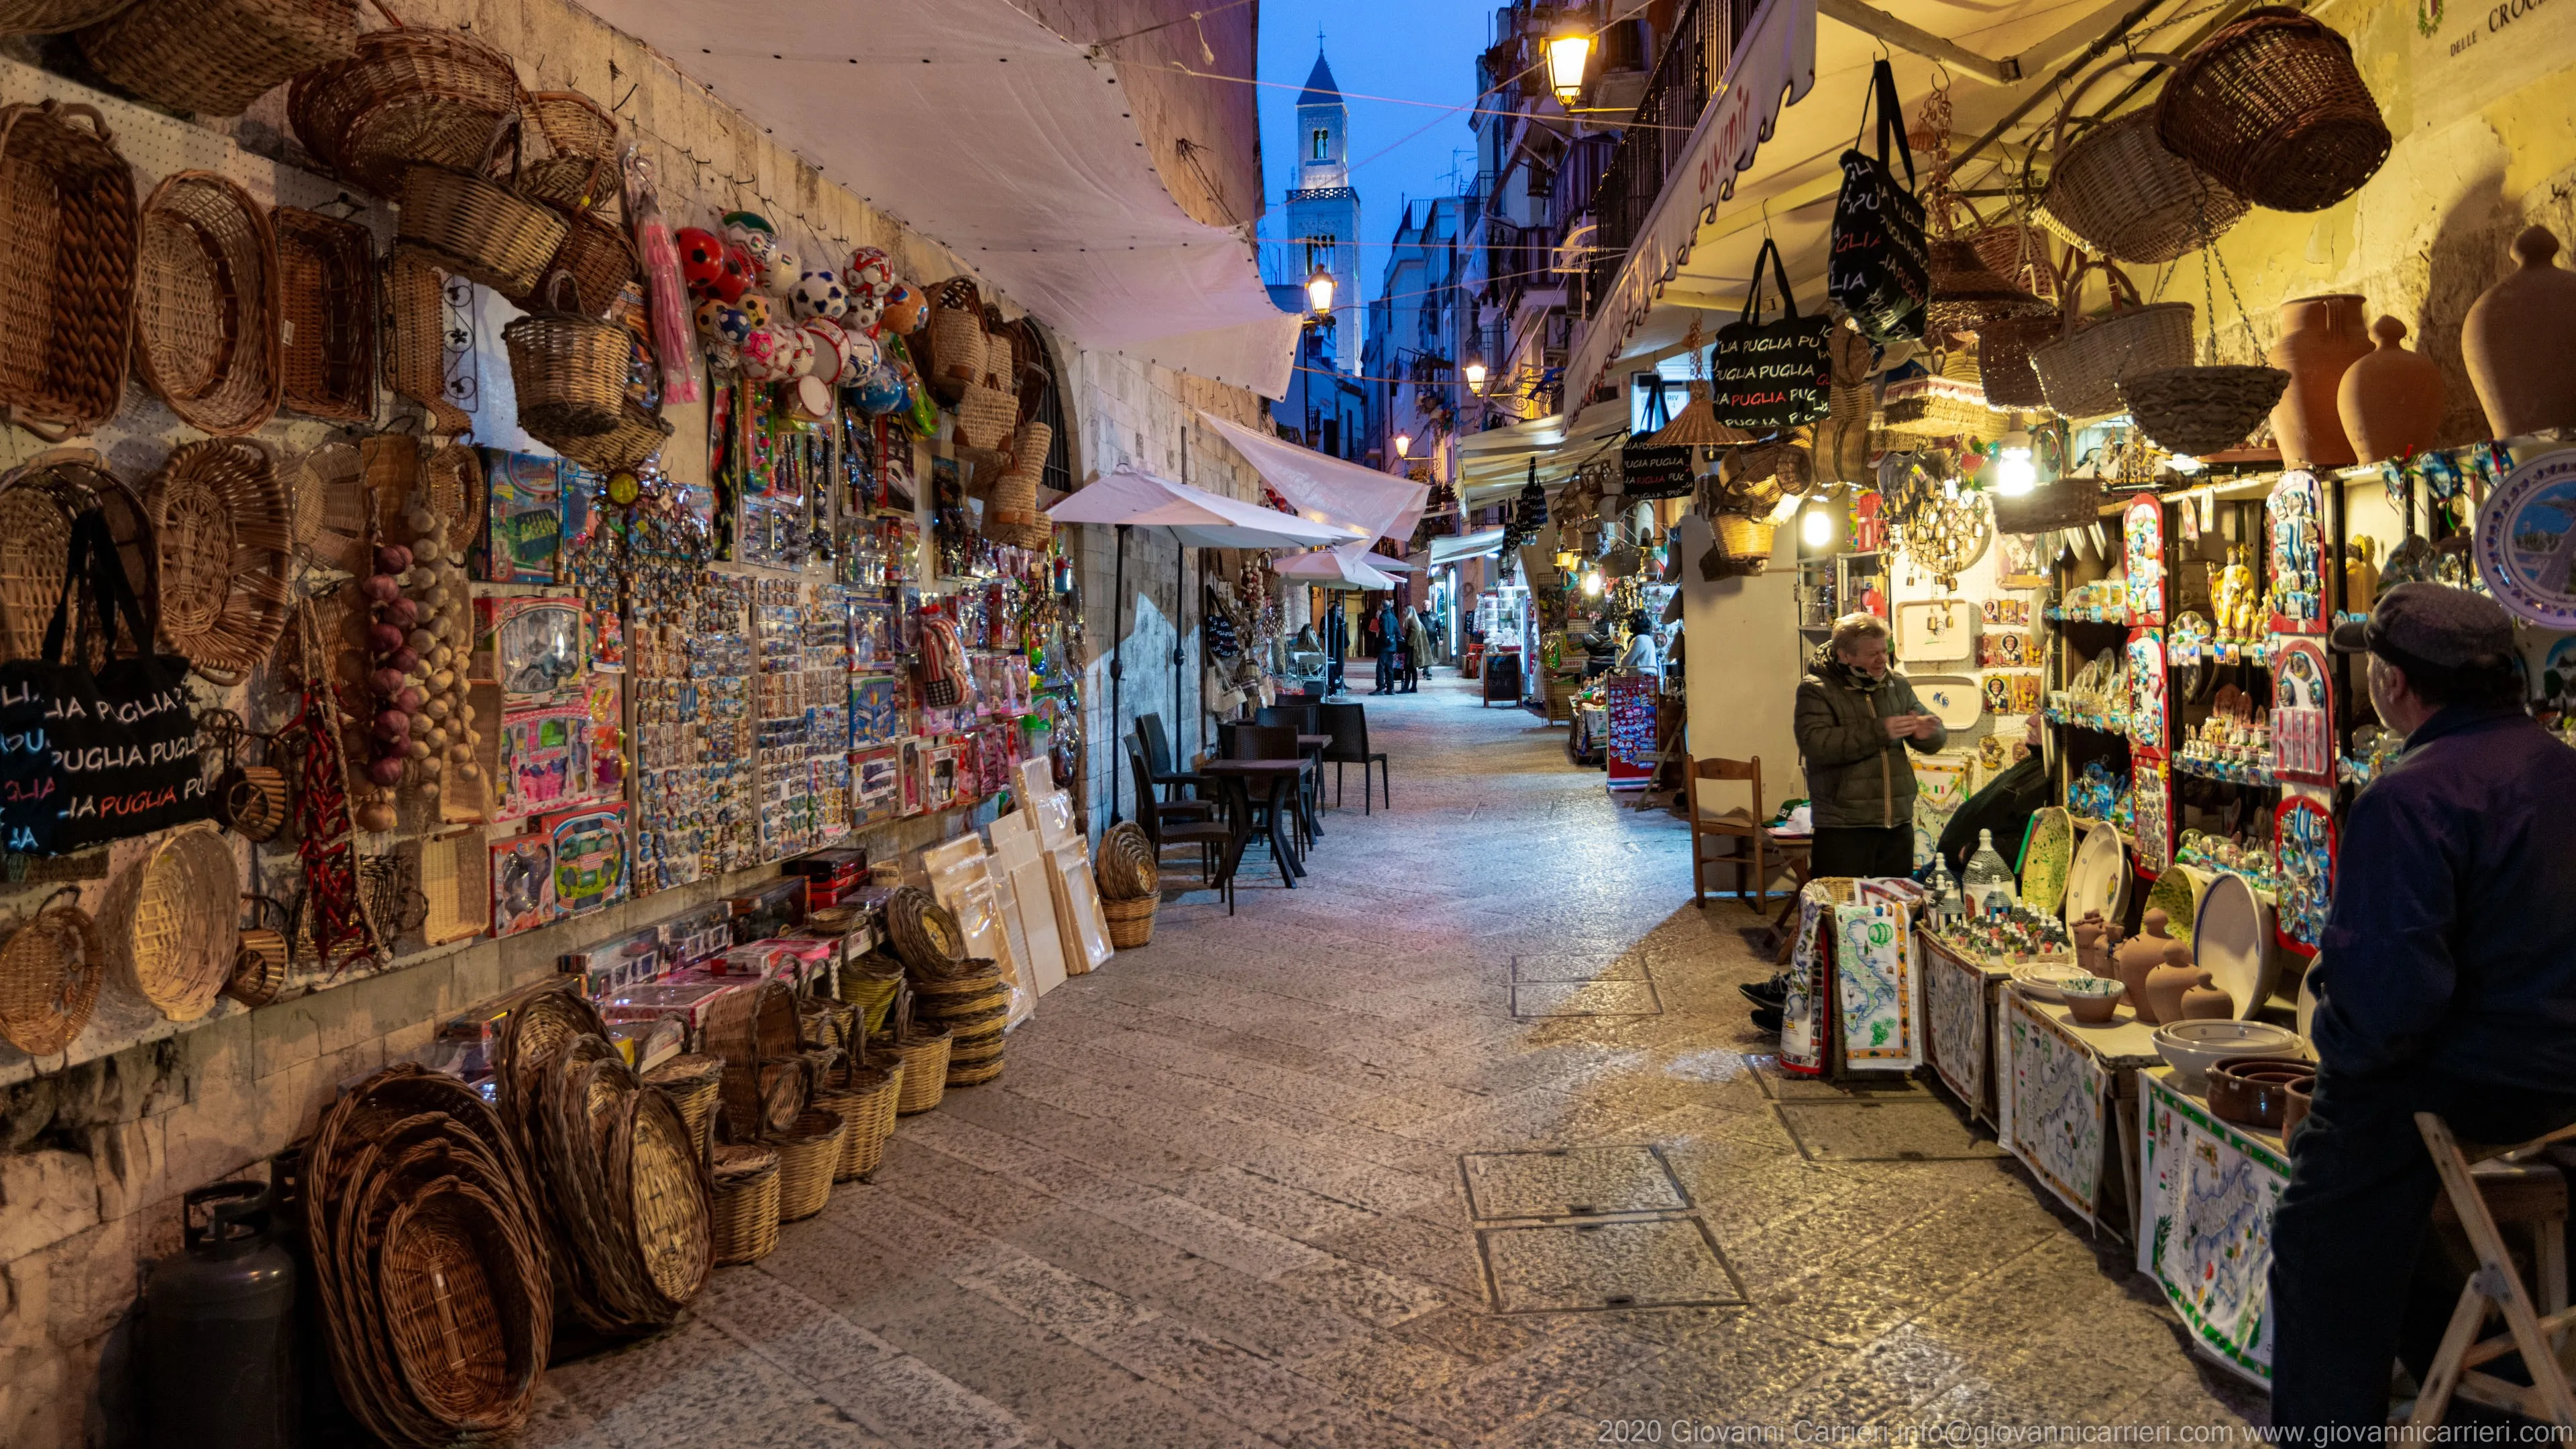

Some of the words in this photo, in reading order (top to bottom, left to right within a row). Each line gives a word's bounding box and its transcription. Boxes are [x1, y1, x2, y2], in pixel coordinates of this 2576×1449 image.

[2450, 30, 2477, 56] DELLE
[755, 233, 774, 264] ITALIA
[1742, 337, 1793, 354] PUGLIA
[1760, 363, 1815, 379] PUGLIA
[1731, 390, 1786, 407] PUGLIA
[1650, 457, 1684, 468] PUGLIA
[100, 784, 178, 819] PUGLIA
